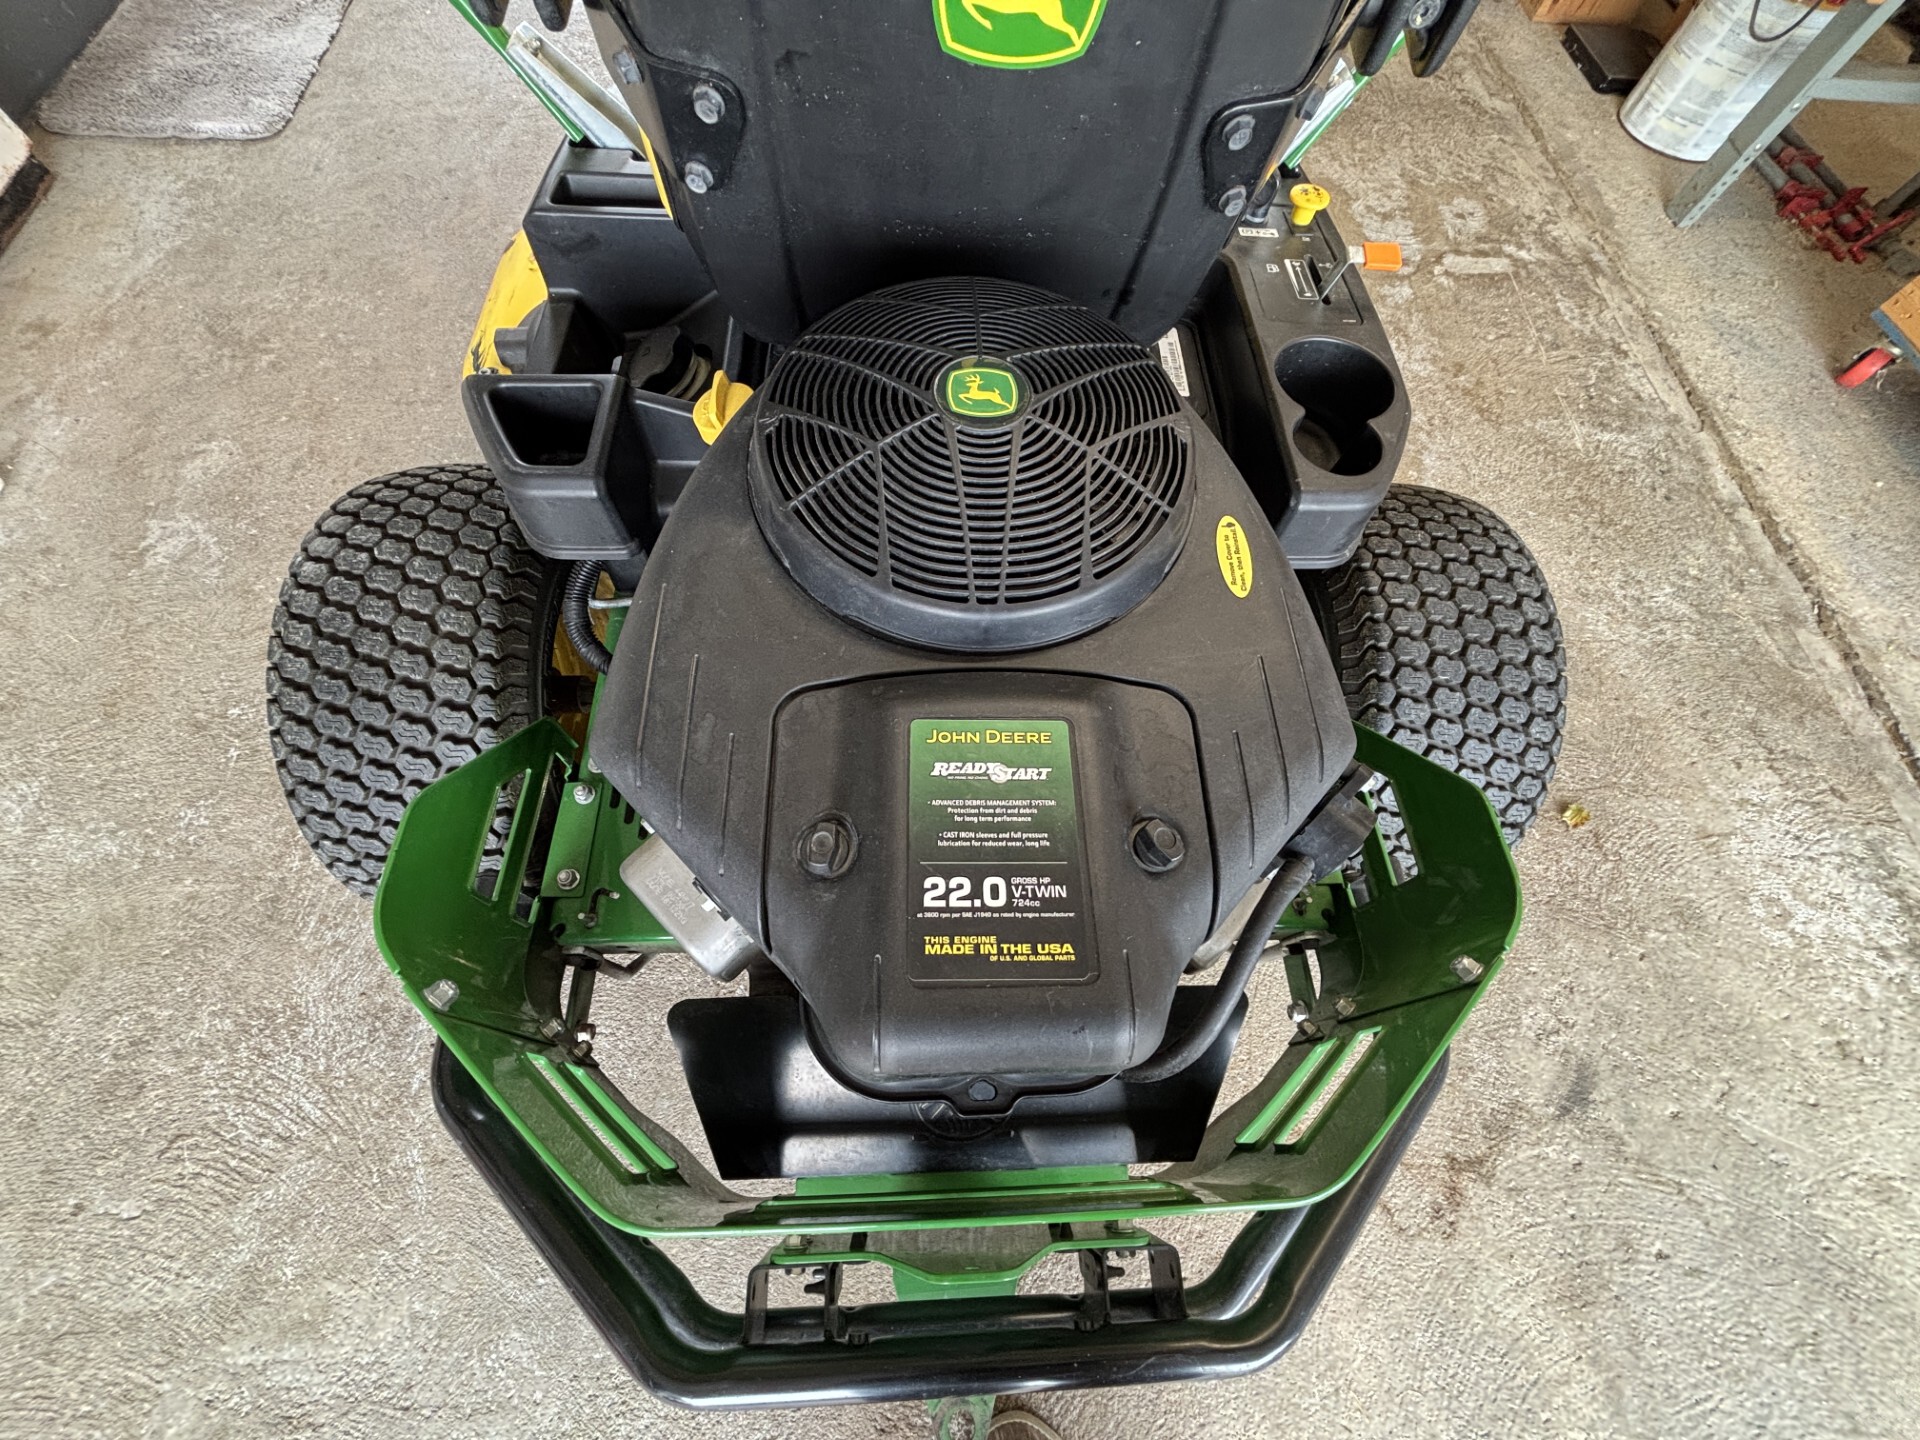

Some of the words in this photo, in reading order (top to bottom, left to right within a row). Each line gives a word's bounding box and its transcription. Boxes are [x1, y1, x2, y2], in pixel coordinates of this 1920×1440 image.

[1236, 556, 1244, 570] then
[1229, 562, 1238, 586] Remove
[926, 730, 980, 744] JOHN
[985, 730, 1052, 744] DEERE
[964, 815, 978, 823] long
[994, 815, 1032, 823] performance
[943, 831, 959, 839] CAST
[959, 831, 975, 839] IRON
[975, 831, 997, 839] sleeves
[998, 831, 1010, 839] and
[1010, 831, 1022, 839] full
[1022, 832, 1049, 840] pressure
[1025, 840, 1039, 848] long
[1011, 877, 1038, 885] GROSS
[1039, 877, 1051, 885] HP
[923, 876, 1007, 908] 22.0
[1011, 885, 1067, 898] V-TWIN
[1011, 899, 1041, 908] 724cc
[924, 936, 950, 944] THIS
[954, 936, 998, 944] ENGINE
[924, 943, 975, 955] MADE
[980, 943, 998, 955] IN
[1000, 943, 1032, 955] THE
[1037, 943, 1075, 955] USA
